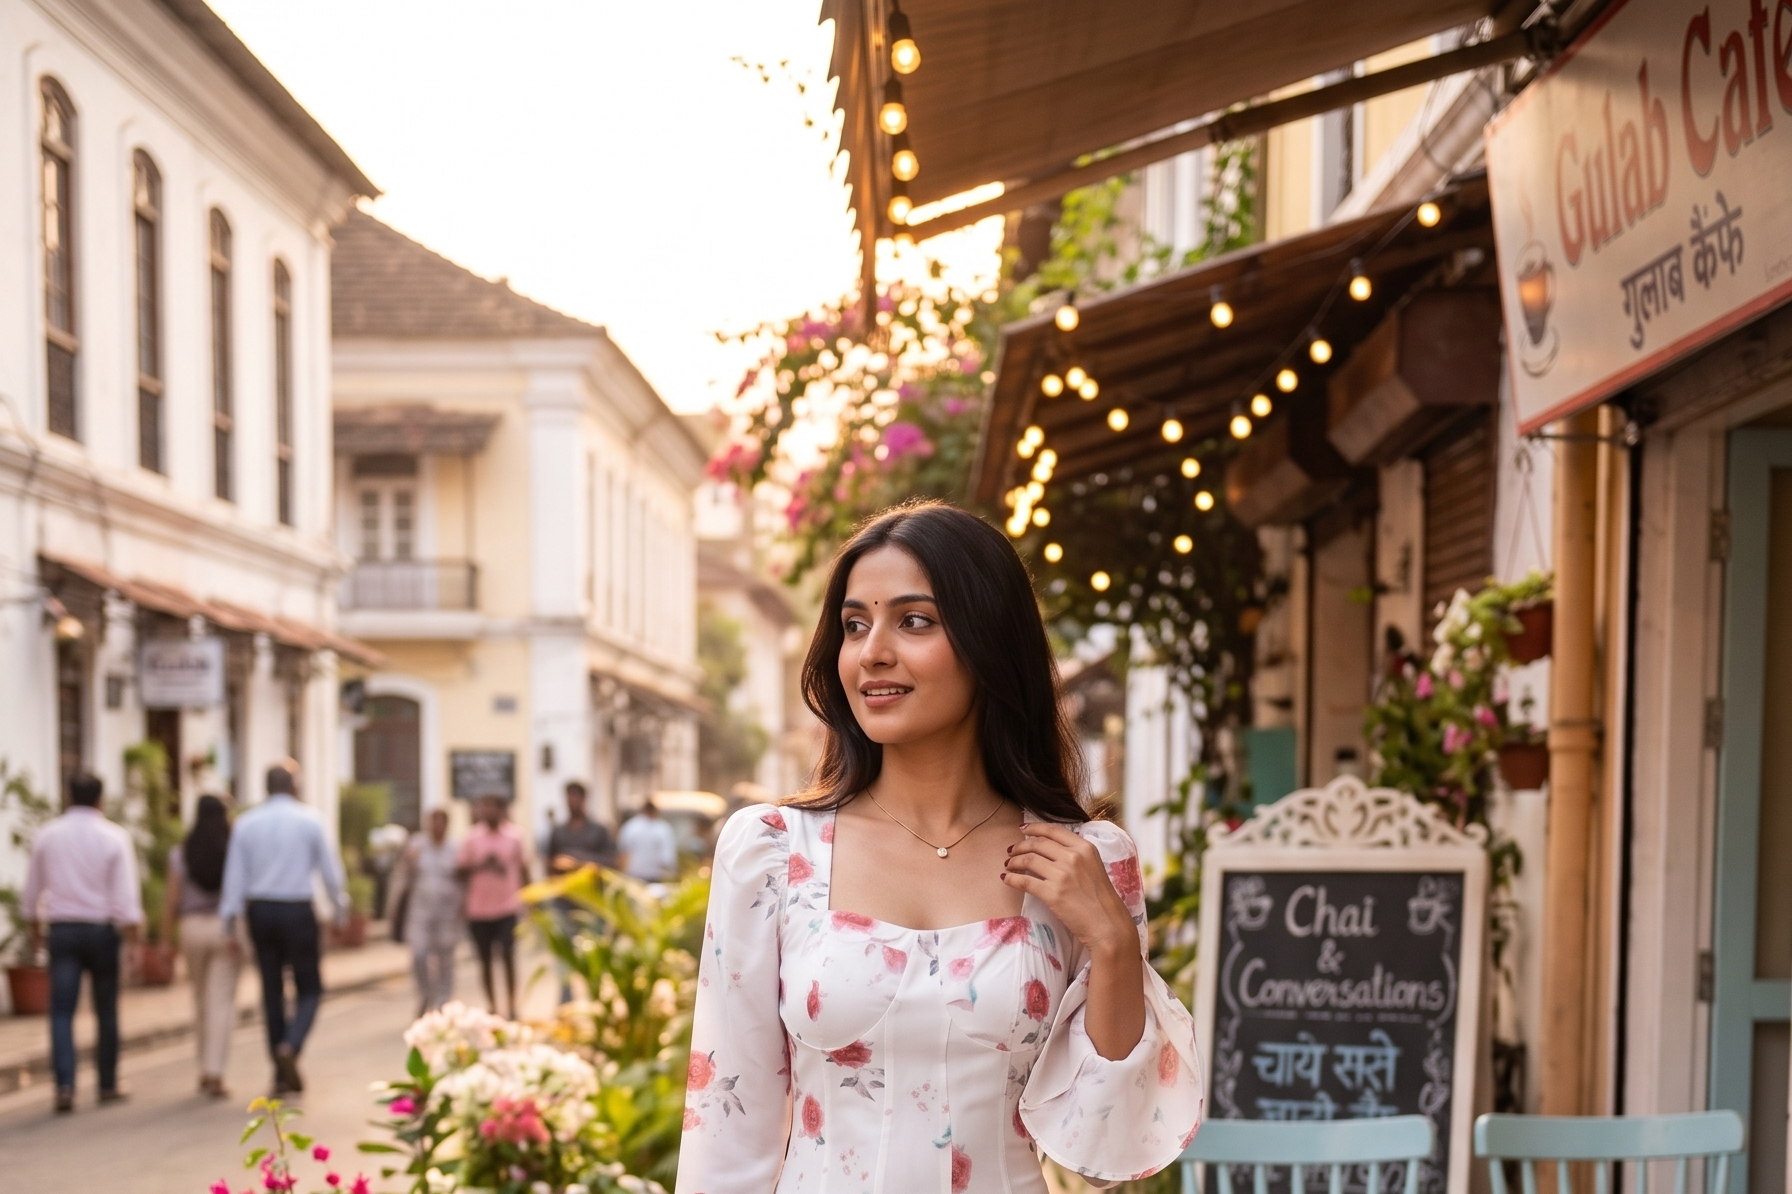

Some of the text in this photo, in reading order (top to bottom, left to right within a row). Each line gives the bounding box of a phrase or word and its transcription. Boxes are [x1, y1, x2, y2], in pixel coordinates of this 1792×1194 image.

[1556, 57, 1670, 267] Gulab
[1620, 242, 1686, 350] गुलाब
[1284, 884, 1379, 938] Chai
[1238, 956, 1446, 1011] Conversations
[1316, 937, 1346, 975] &
